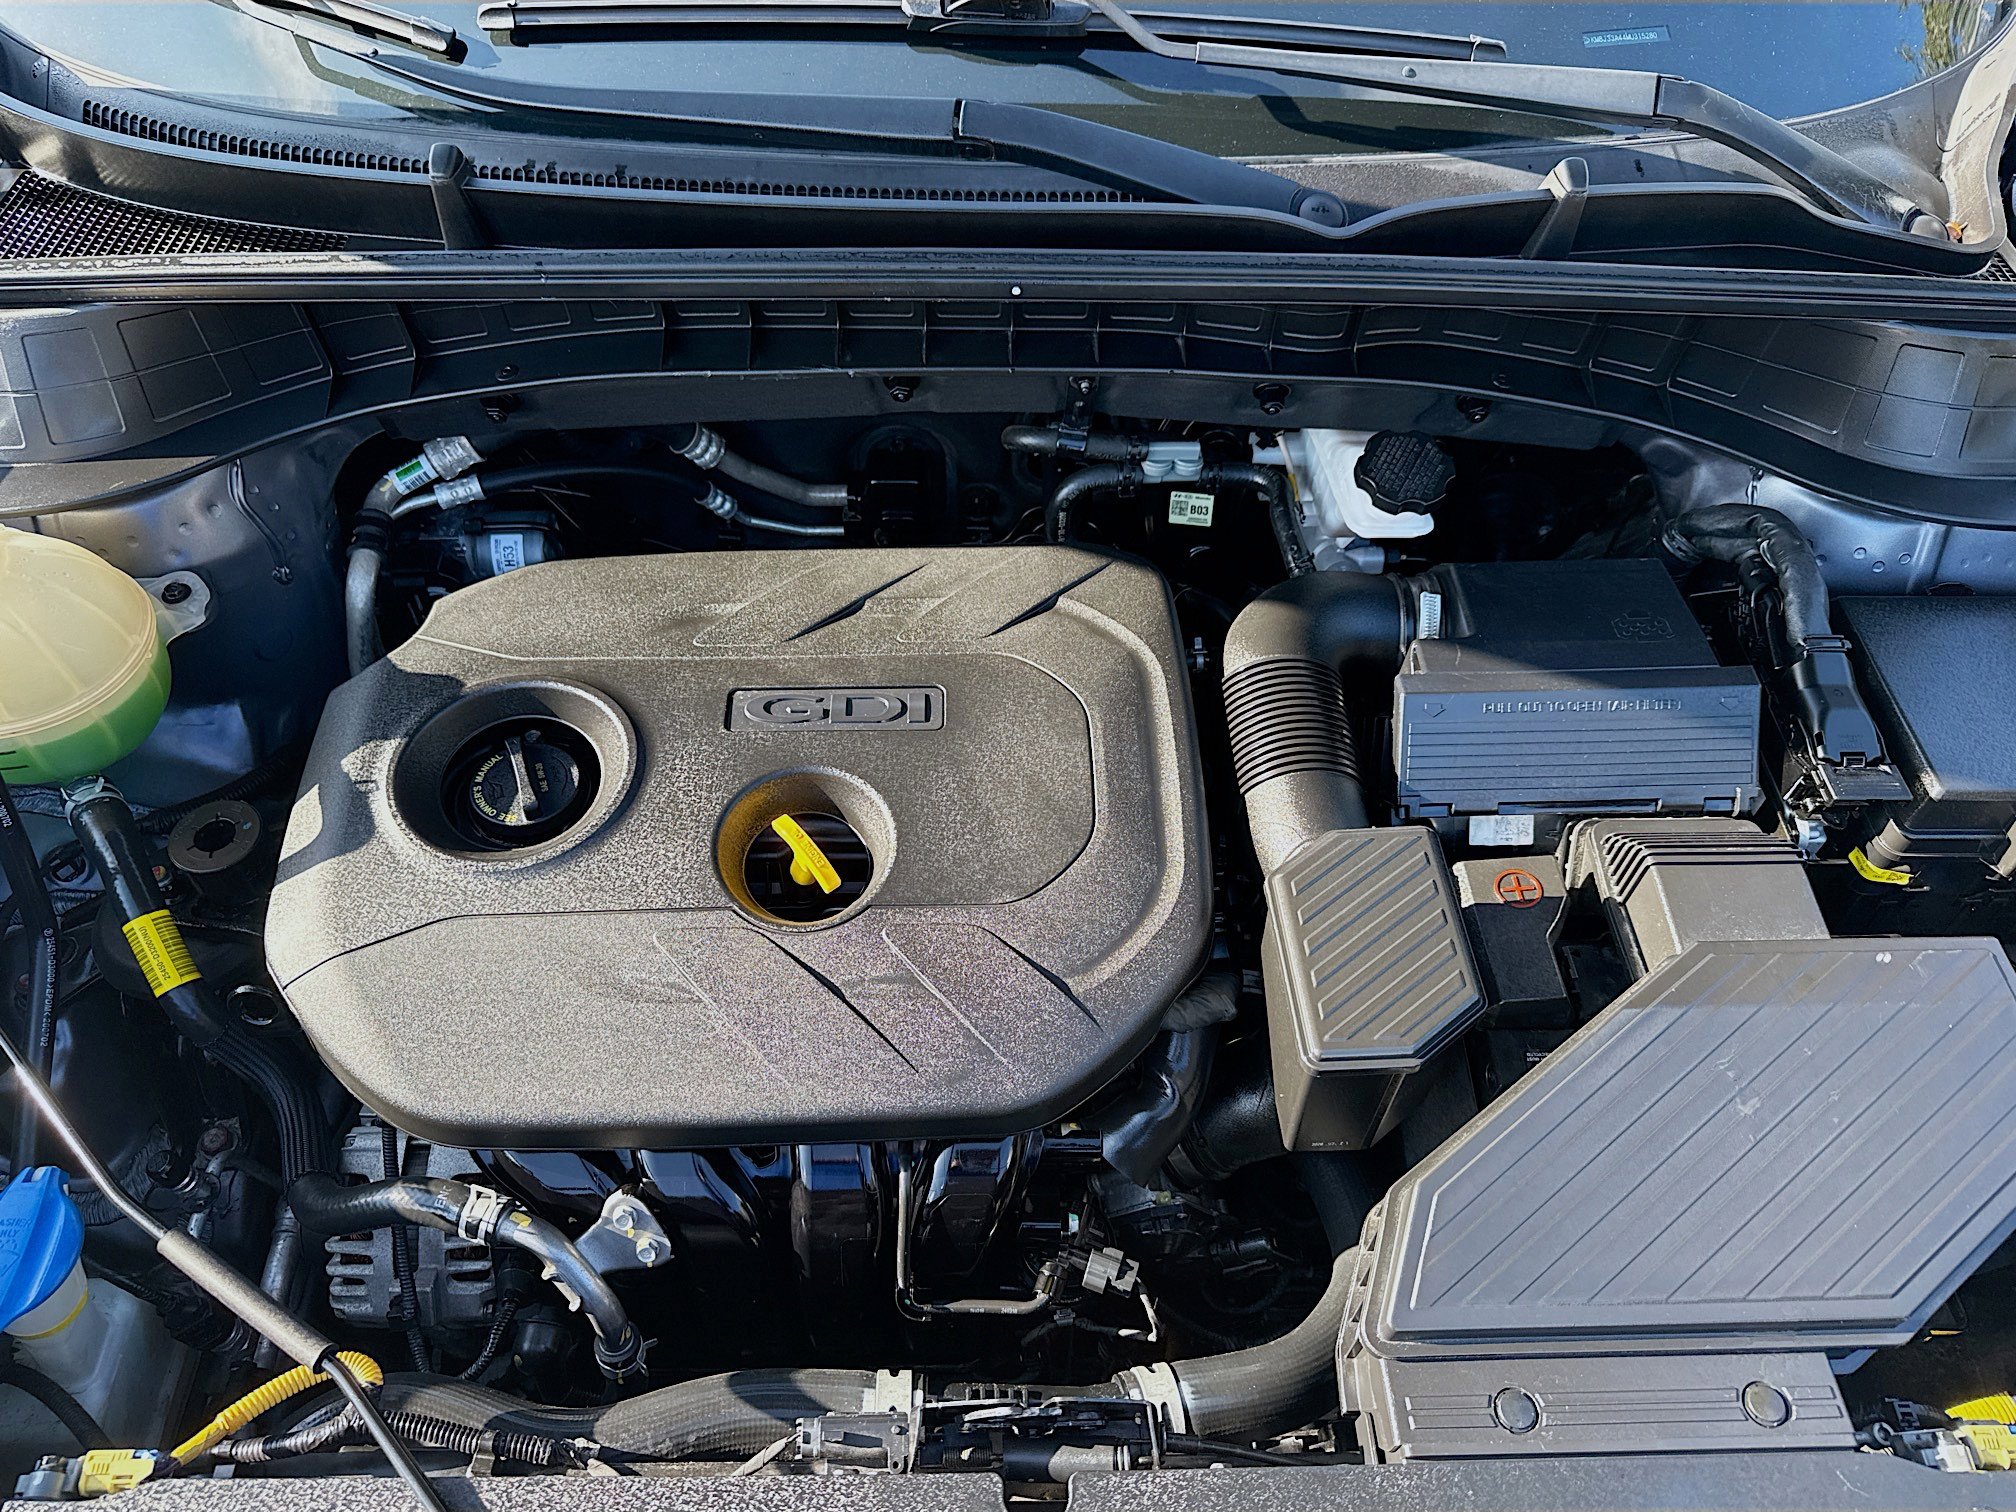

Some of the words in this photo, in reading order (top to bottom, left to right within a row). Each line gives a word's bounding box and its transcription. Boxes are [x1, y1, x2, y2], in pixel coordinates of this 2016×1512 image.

[1190, 505, 1209, 516] B03
[503, 546, 516, 567] H53
[744, 693, 932, 724] GDI
[1482, 702, 1516, 713] PULL
[1518, 701, 1543, 712] OUT
[1546, 701, 1564, 712] TO
[1567, 700, 1602, 712] OPEN
[474, 753, 504, 783] MANUAL
[40, 1016, 52, 1048] 200702
